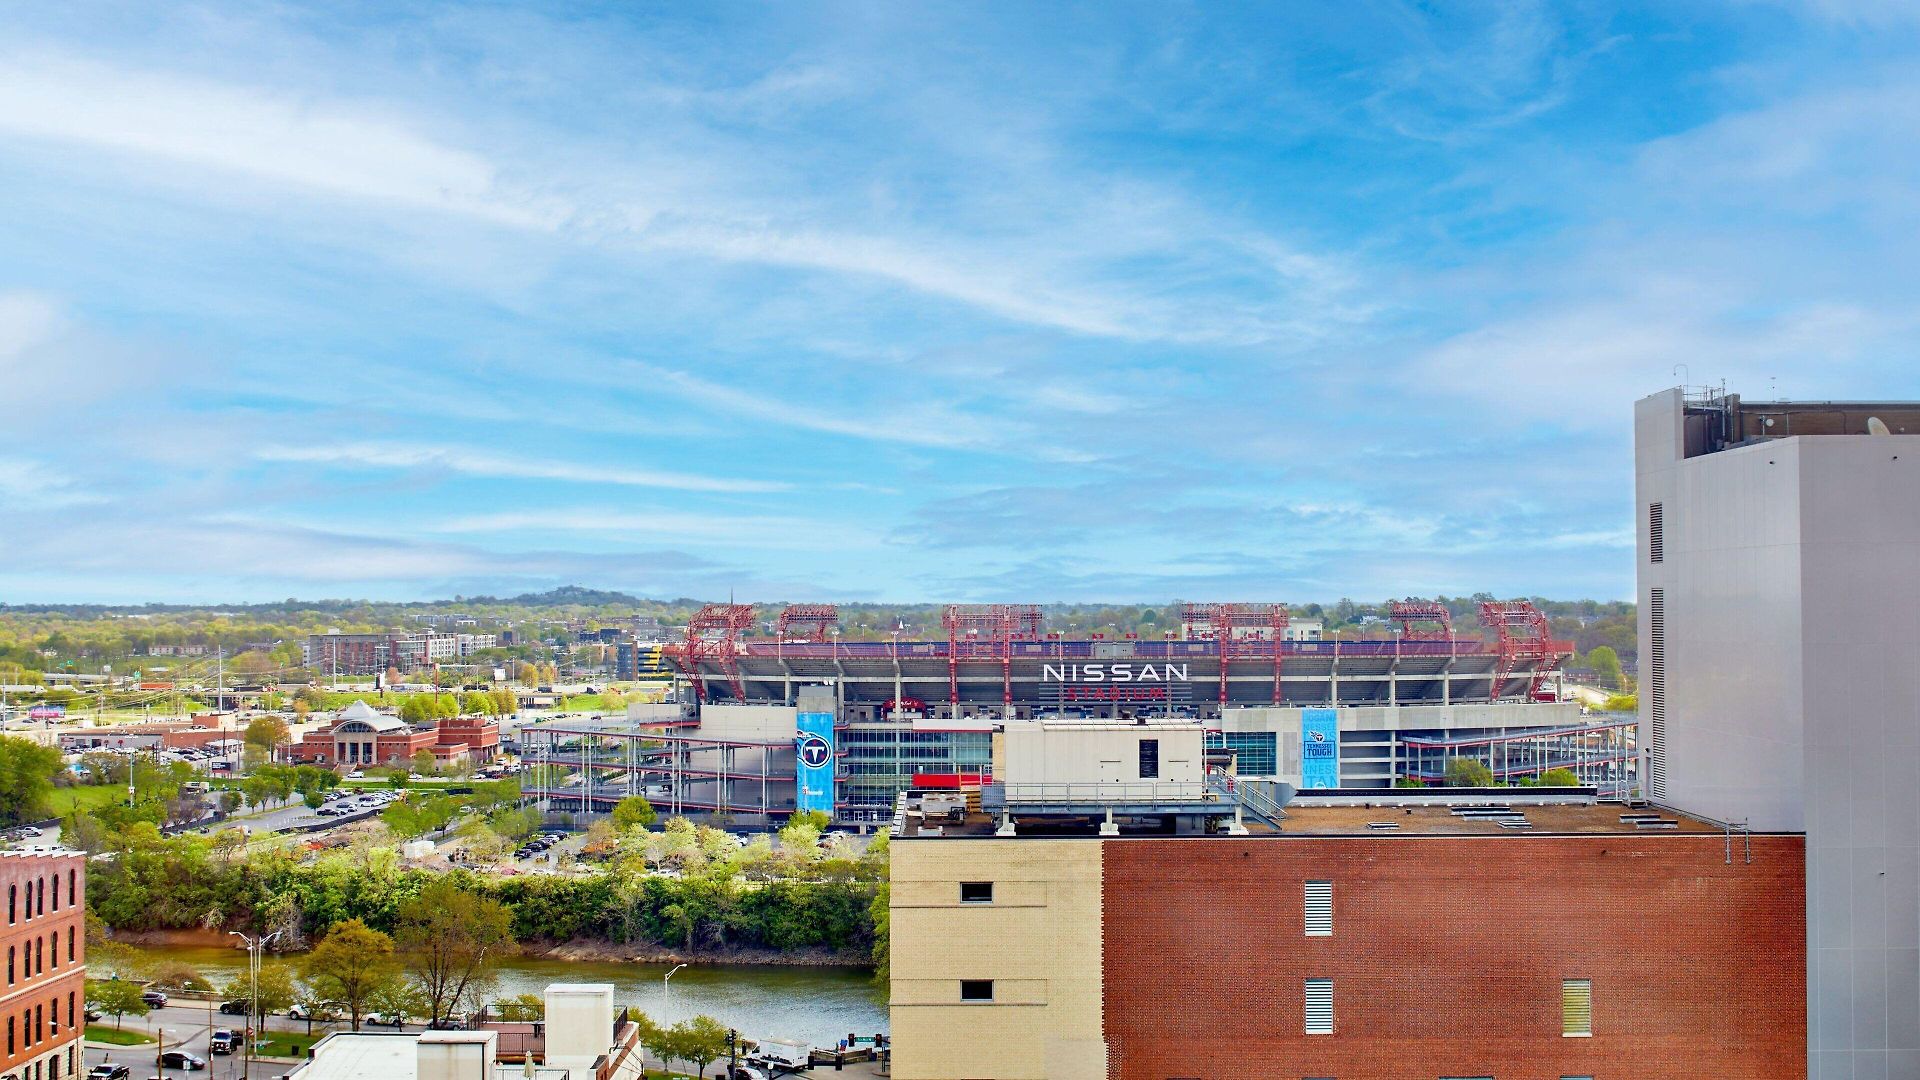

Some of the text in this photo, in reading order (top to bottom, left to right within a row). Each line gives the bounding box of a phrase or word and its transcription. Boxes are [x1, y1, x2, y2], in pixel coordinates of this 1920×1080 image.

[1043, 663, 1188, 682] NISSAN
[1067, 687, 1164, 700] STADIUM
[806, 747, 825, 762] T
[1306, 748, 1332, 756] TOUGH
